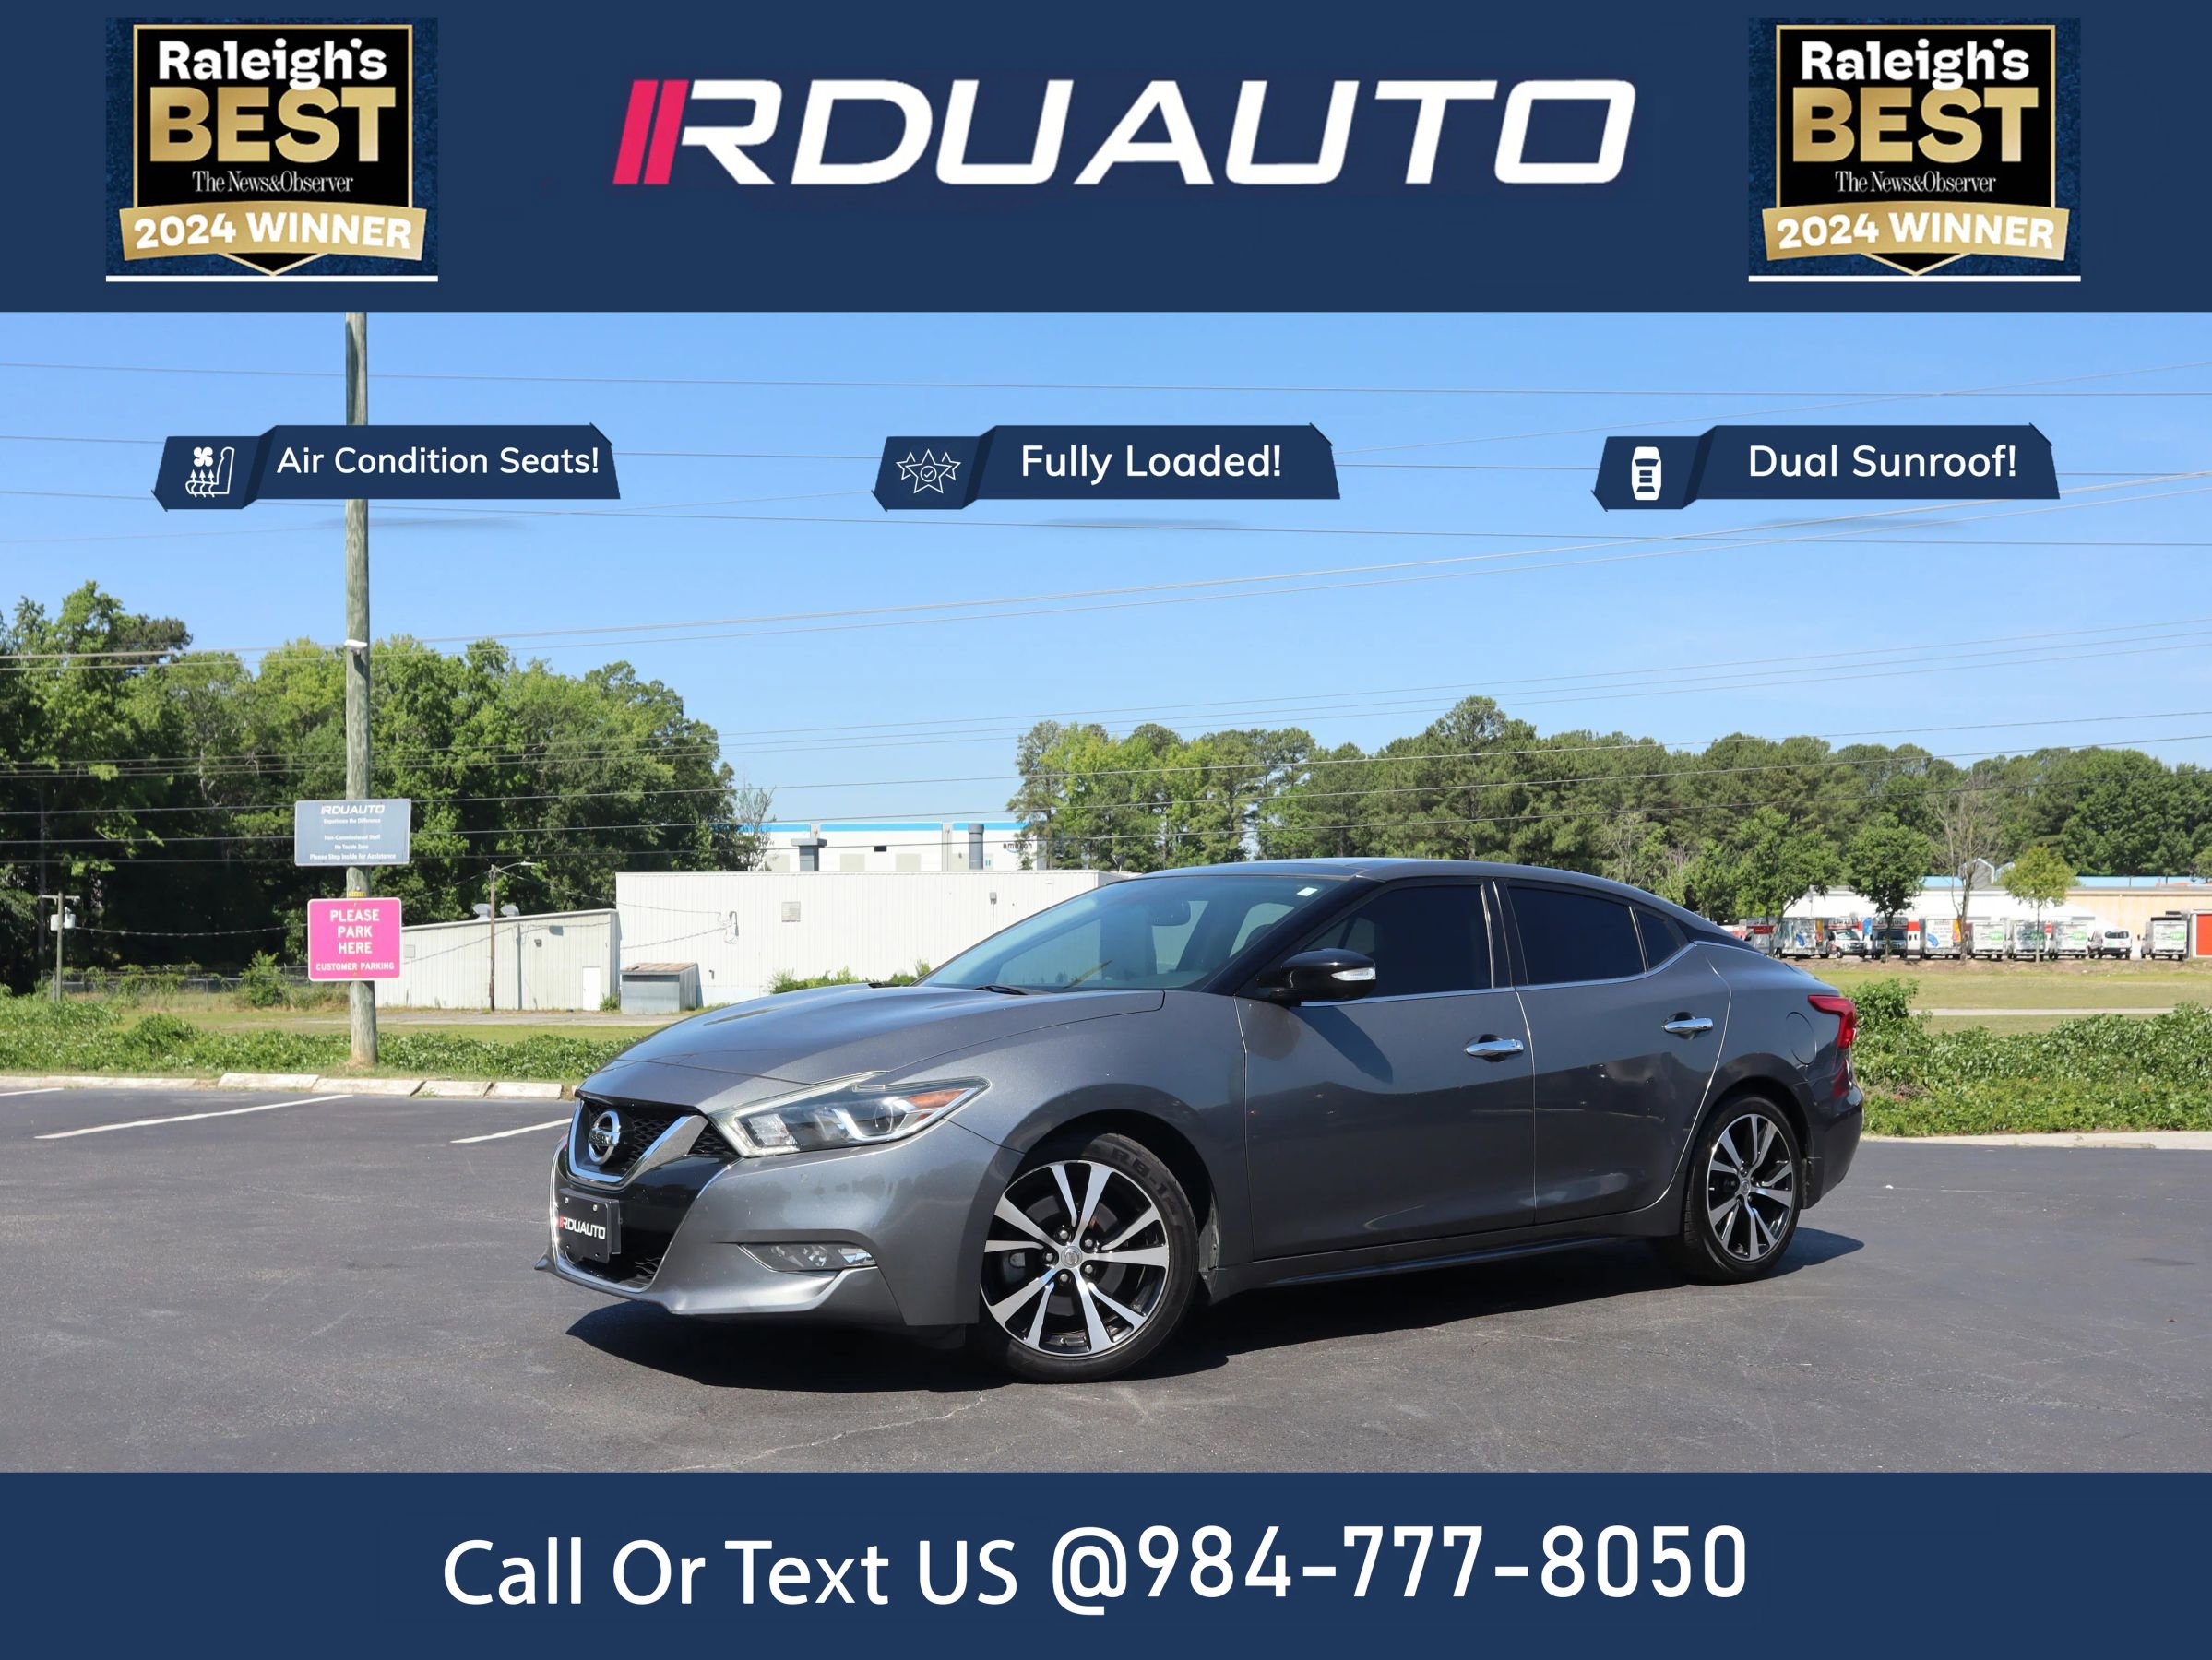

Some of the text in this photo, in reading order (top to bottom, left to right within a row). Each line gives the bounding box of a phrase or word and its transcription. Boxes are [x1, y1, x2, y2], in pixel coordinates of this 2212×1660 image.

[322, 804, 386, 815] RDUAUTO
[329, 908, 380, 922] PLEASE
[337, 925, 373, 939] PARK
[338, 941, 373, 954] HERE
[315, 961, 395, 971] CUSTOMER PARKING
[561, 1215, 606, 1240] RDUAUTO
